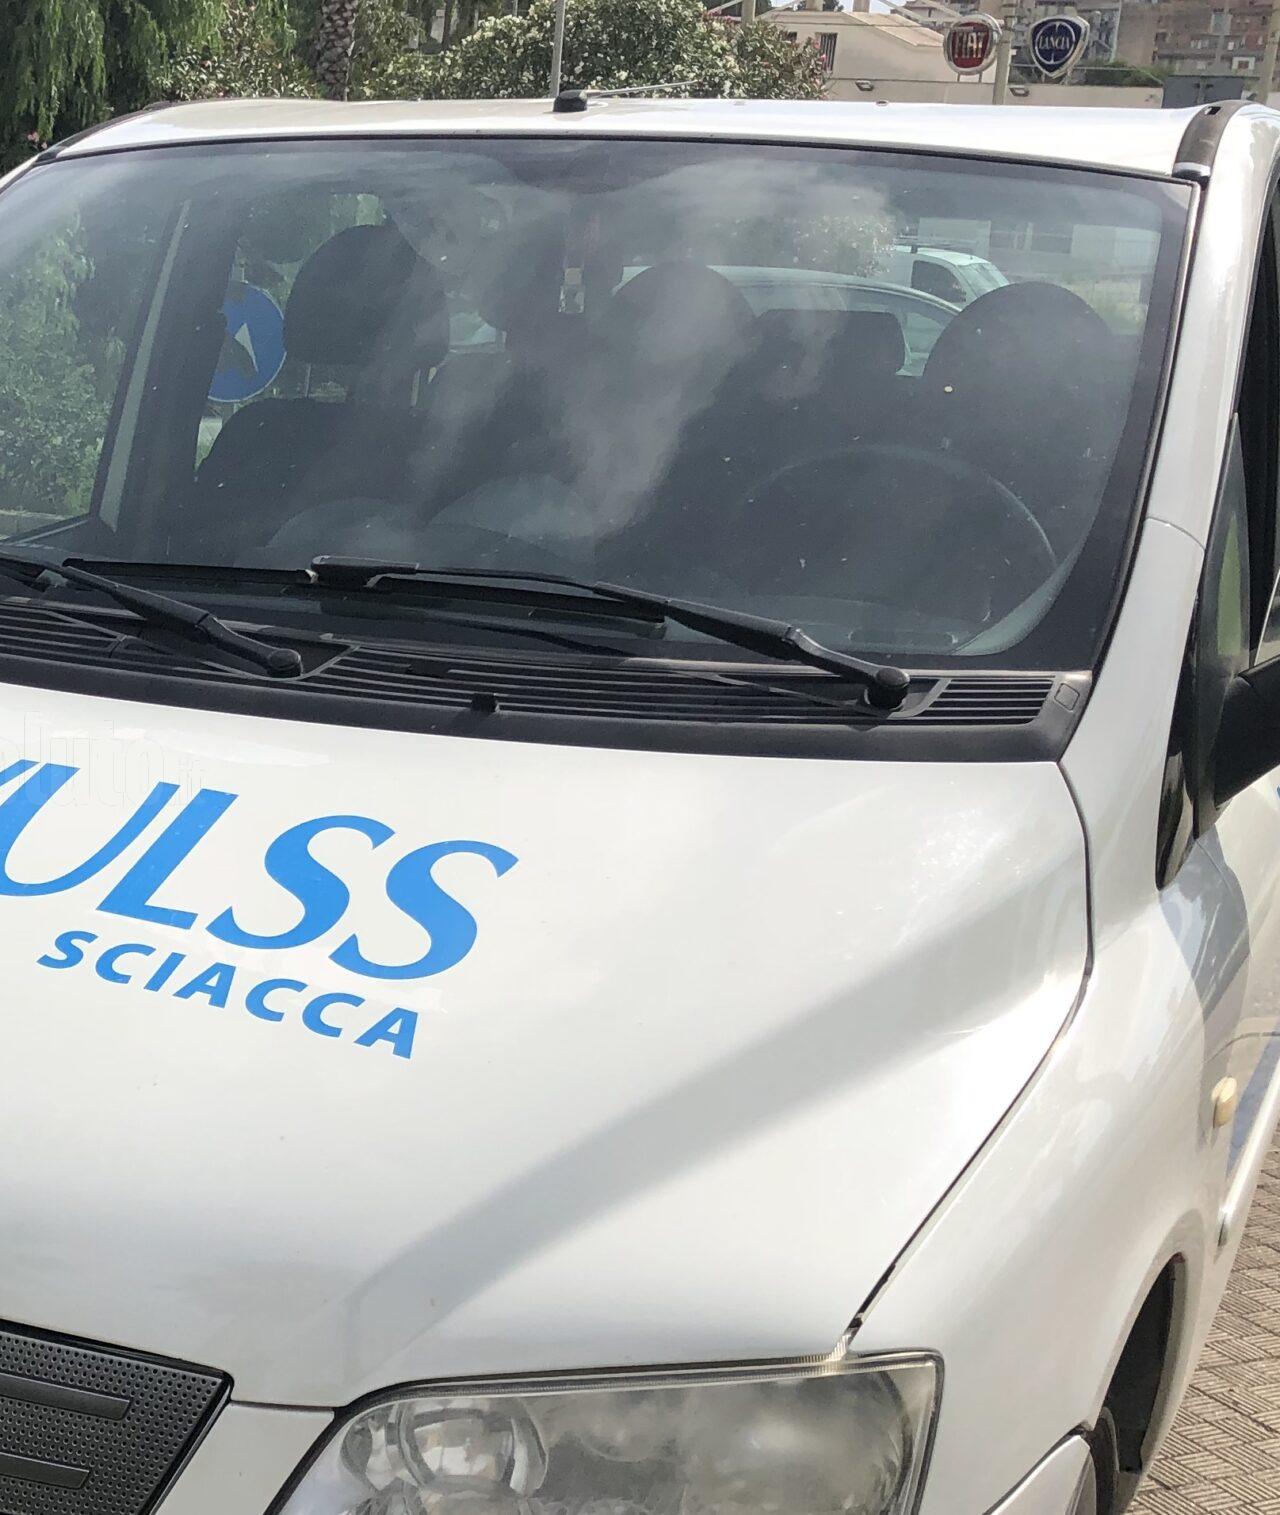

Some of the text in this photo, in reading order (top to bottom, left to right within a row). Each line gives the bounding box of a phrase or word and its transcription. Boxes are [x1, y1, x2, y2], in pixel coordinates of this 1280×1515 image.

[953, 26, 986, 58] FIAT
[1039, 36, 1070, 50] LANCIA
[38, 930, 418, 1059] SCIACCA
